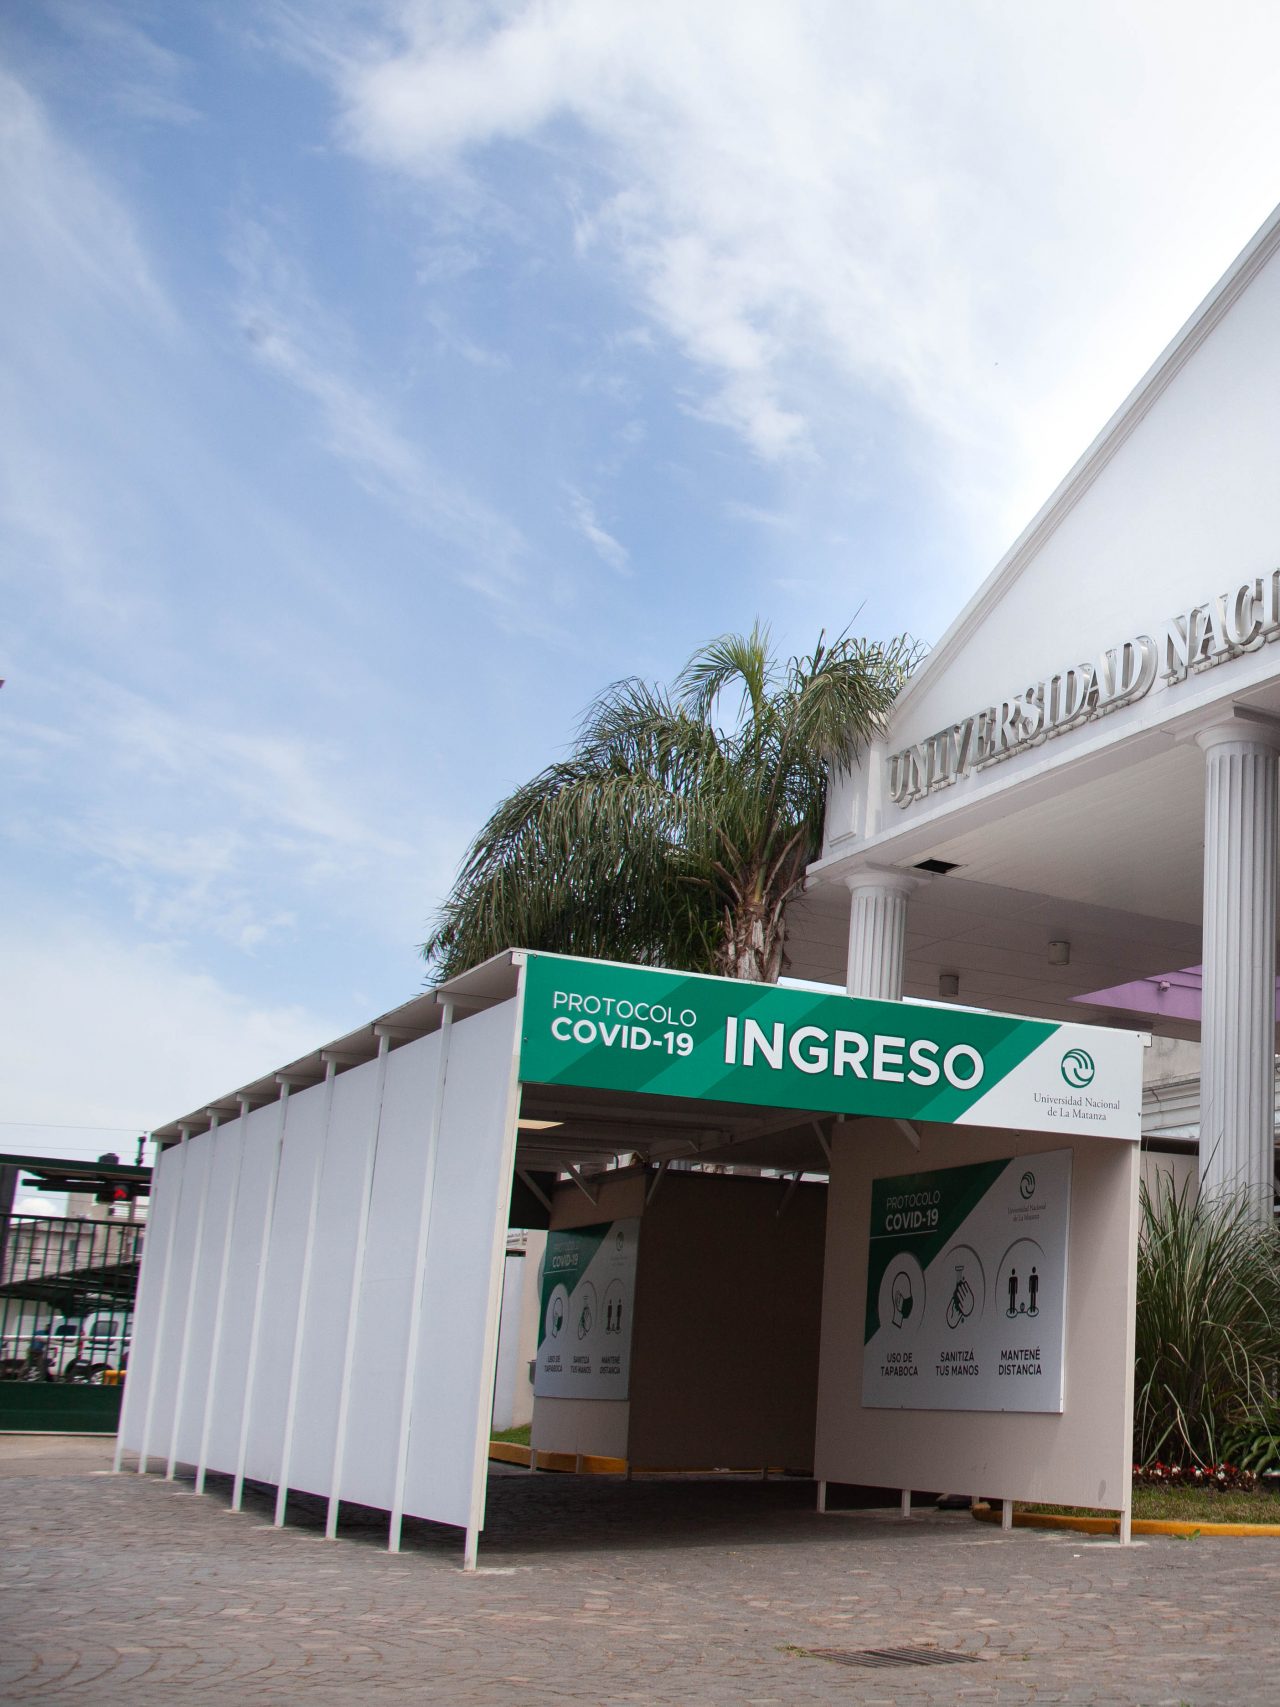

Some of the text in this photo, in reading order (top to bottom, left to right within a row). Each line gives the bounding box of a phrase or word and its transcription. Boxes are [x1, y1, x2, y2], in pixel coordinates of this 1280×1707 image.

[889, 634, 1158, 808] UNIVERSIDAD
[553, 990, 698, 1028] PROTOCOLO
[551, 1016, 695, 1057] COVID-19
[724, 1016, 985, 1090] INGRESO
[1033, 1092, 1121, 1110] Universidad Nacional
[1047, 1106, 1107, 1121] de La Matanza
[886, 1190, 941, 1210] PROTOCOLO
[885, 1208, 939, 1231] COVID-19
[887, 1352, 913, 1363] USO DE
[1000, 1346, 1041, 1361] MANTENÉ
[881, 1366, 918, 1377] TAPABOCA
[936, 1365, 979, 1376] TUS MANOS
[998, 1364, 1042, 1376] DISTANCIA
